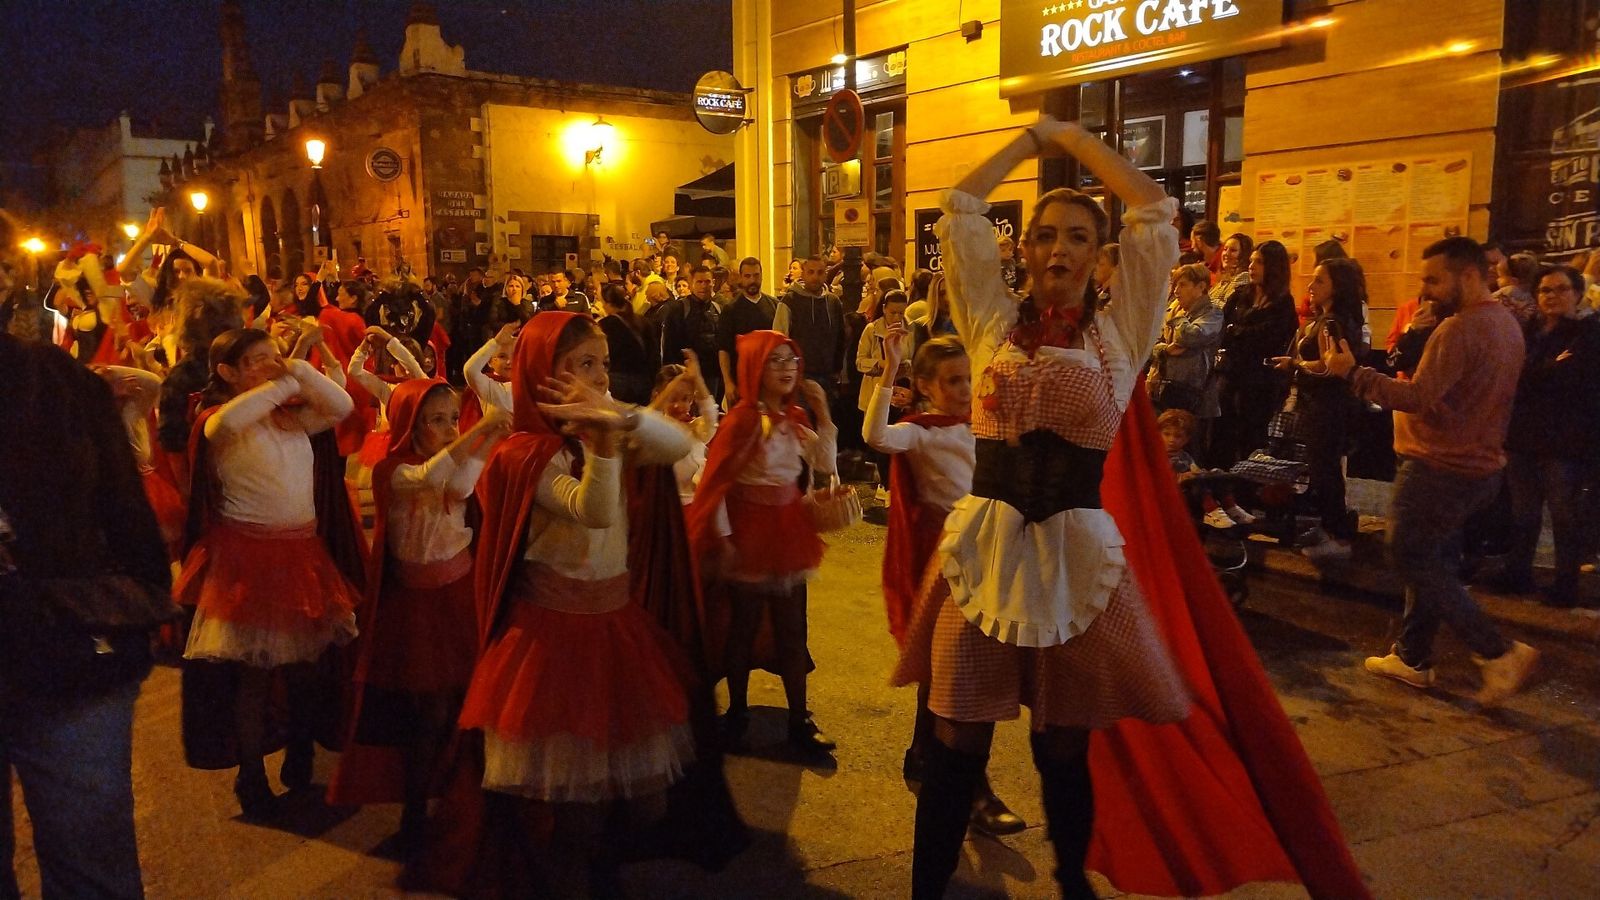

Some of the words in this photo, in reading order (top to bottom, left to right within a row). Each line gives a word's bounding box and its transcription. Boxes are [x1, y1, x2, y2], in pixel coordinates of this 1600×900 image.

[1040, 6, 1128, 57] ROCK
[1167, 31, 1187, 43] BAR
[697, 96, 720, 107] ROCK
